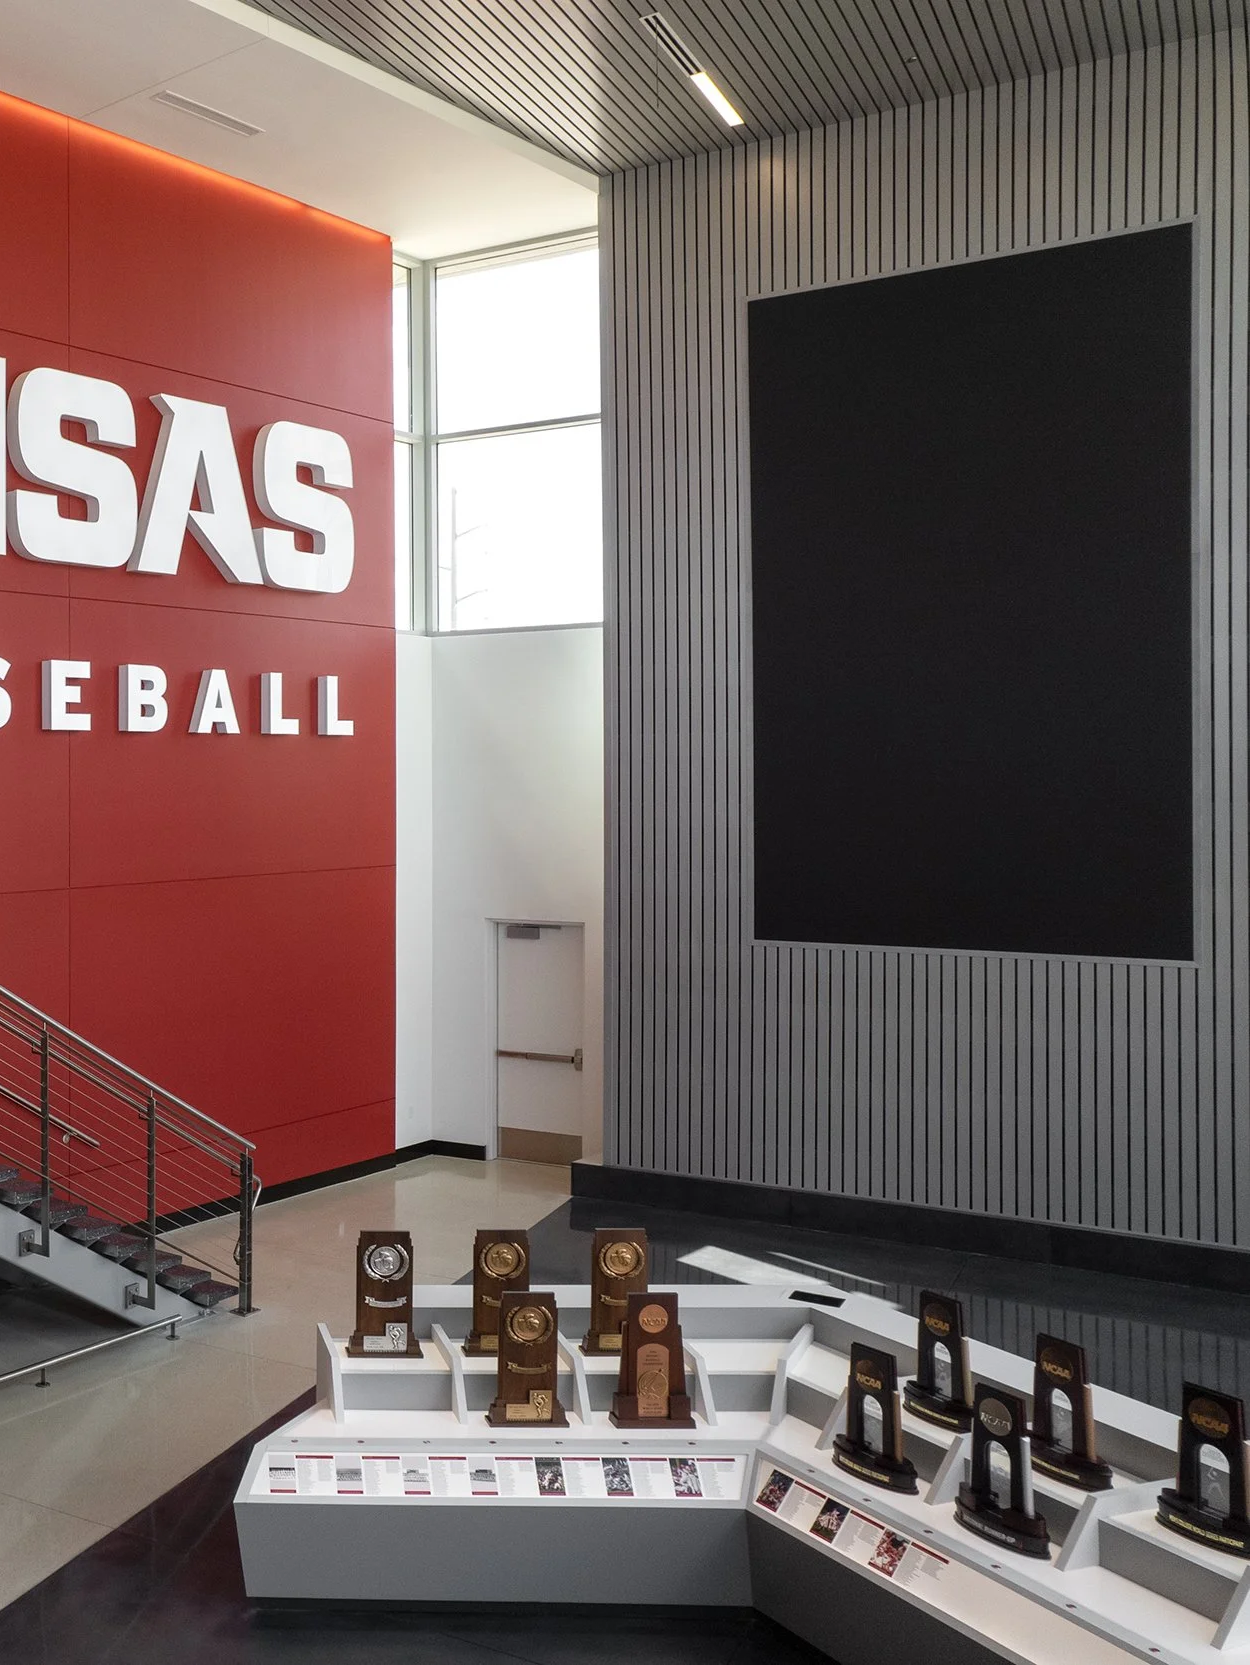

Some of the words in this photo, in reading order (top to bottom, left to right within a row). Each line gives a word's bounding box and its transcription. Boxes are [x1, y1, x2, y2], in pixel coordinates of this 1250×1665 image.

[925, 1315, 950, 1331] NCAA
[1041, 1360, 1071, 1381] NCAA
[856, 1372, 882, 1390] NCAA
[980, 1411, 1010, 1431] NCAA
[1190, 1412, 1229, 1435] NCAA
